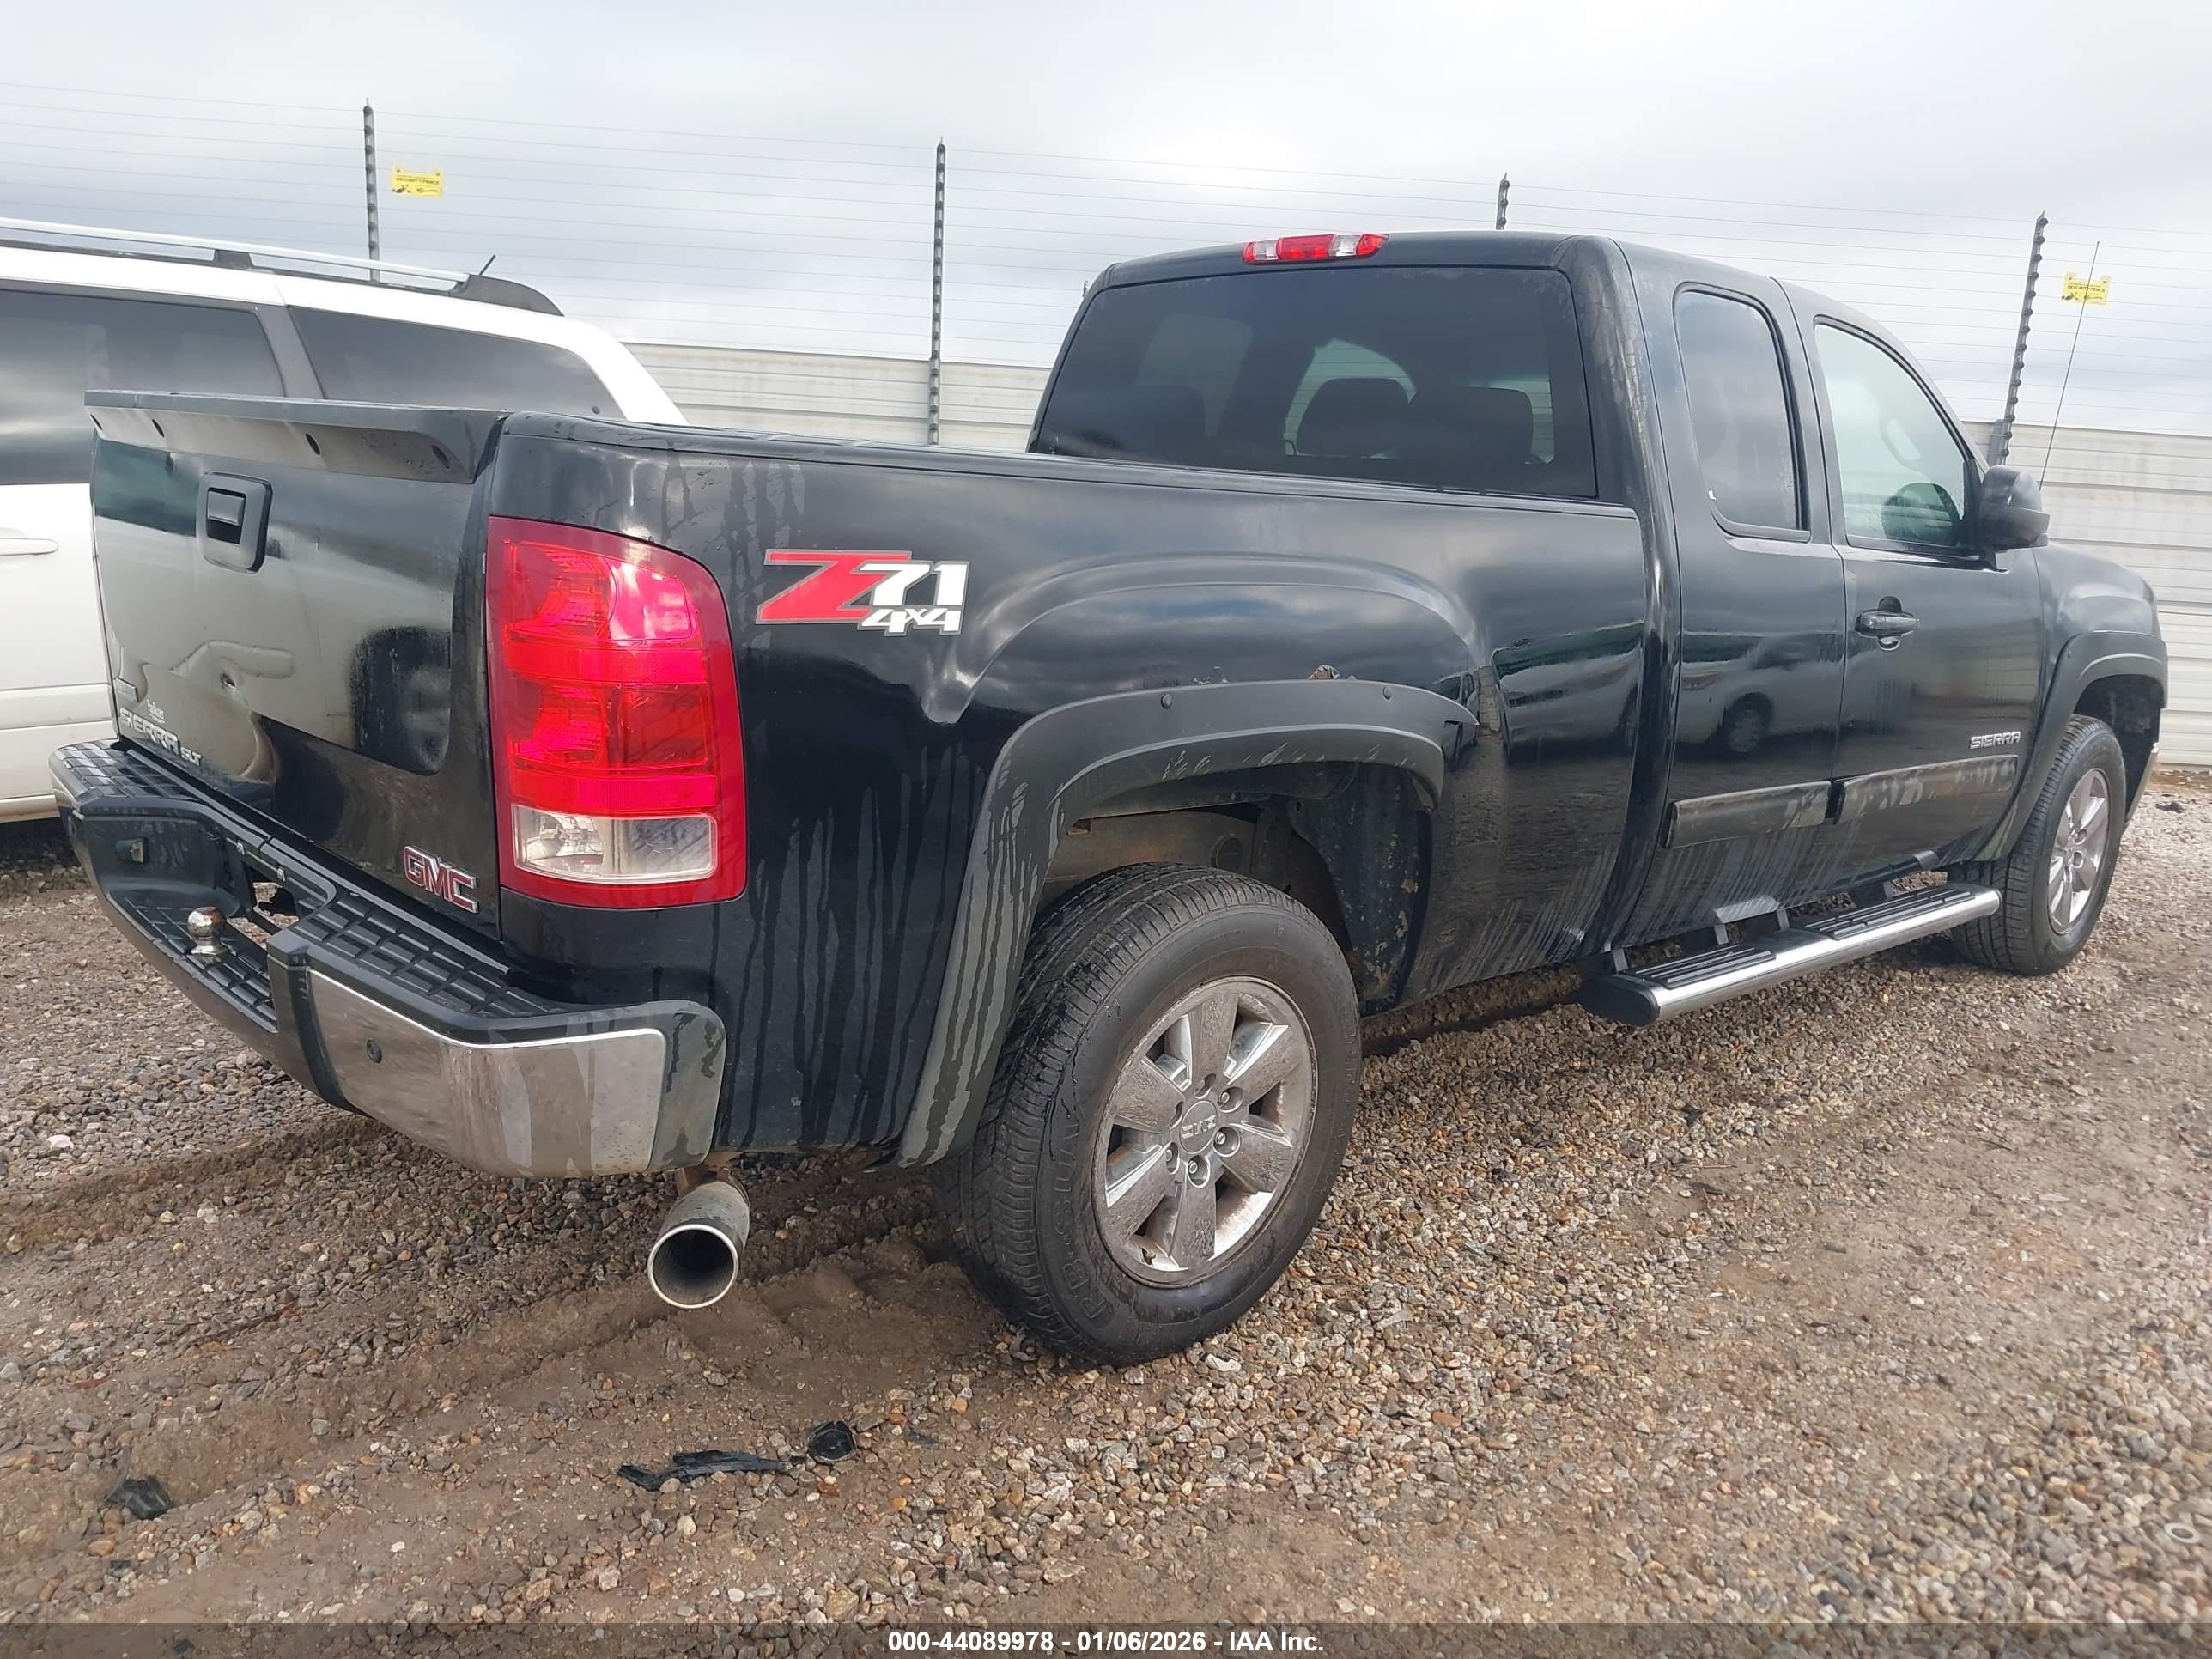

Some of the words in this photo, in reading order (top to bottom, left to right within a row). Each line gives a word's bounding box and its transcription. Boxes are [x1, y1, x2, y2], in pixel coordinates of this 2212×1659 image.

[756, 549, 970, 625] Z71
[120, 707, 179, 757] SIERRA
[180, 746, 201, 767] SLT
[1969, 730, 2021, 750] SIERRA
[403, 844, 479, 915] GMC
